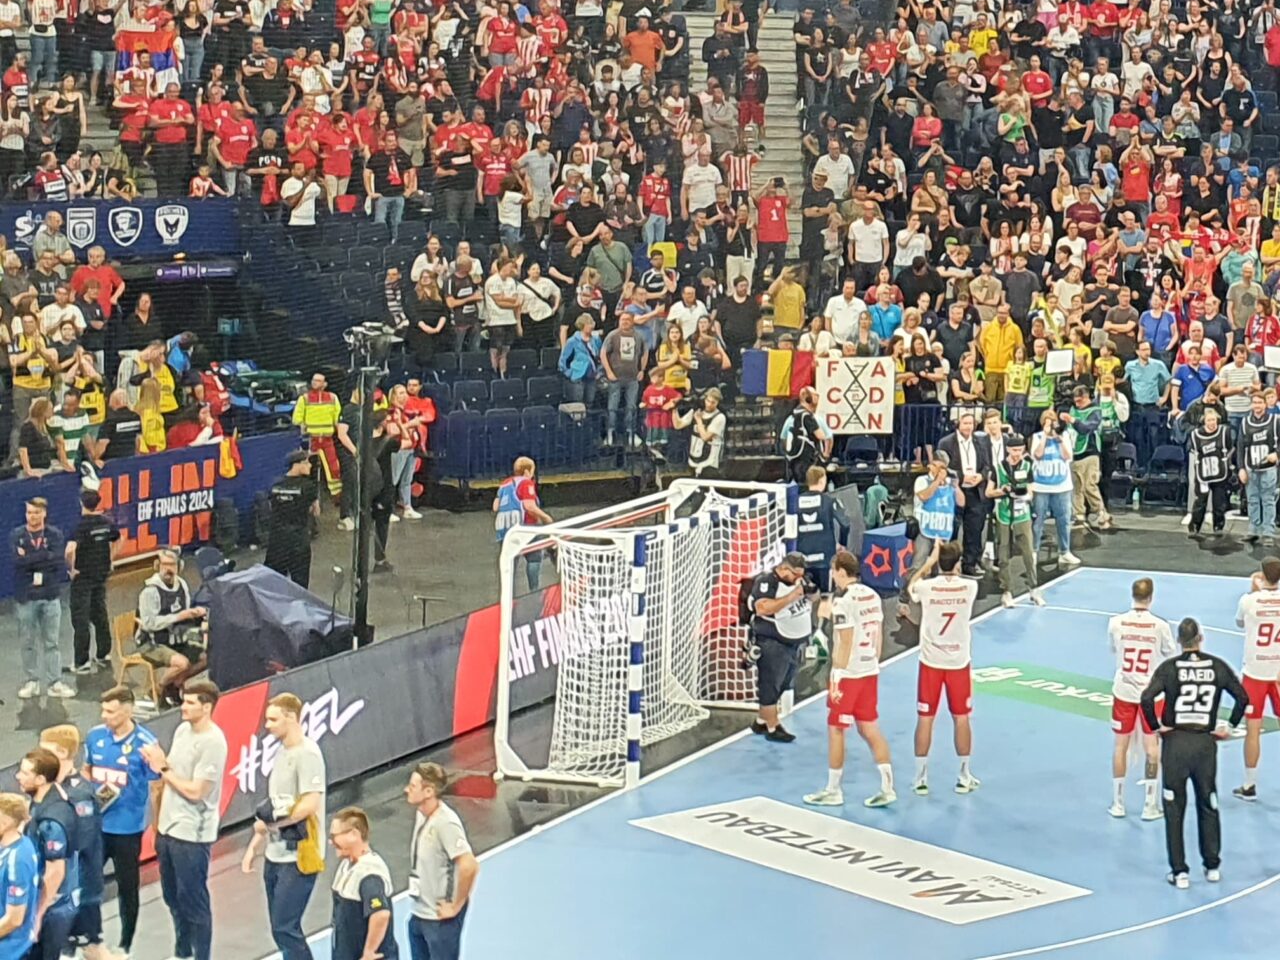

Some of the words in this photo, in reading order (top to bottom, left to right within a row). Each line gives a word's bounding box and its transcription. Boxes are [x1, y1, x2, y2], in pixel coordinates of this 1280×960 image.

[827, 361, 839, 377] F
[871, 361, 886, 377] A
[827, 387, 841, 404] C
[869, 387, 884, 403] D
[826, 414, 841, 430] D
[868, 413, 882, 430] N
[1201, 456, 1219, 477] HB
[138, 499, 153, 521] EHF
[155, 494, 187, 517] FINALS
[189, 489, 214, 512] 2024
[939, 612, 957, 636] 7
[1122, 647, 1152, 673] 55
[1178, 668, 1215, 682] SAEID
[1174, 684, 1216, 713] 23
[694, 811, 883, 867] NETZBAU
[870, 859, 953, 883] AVI
